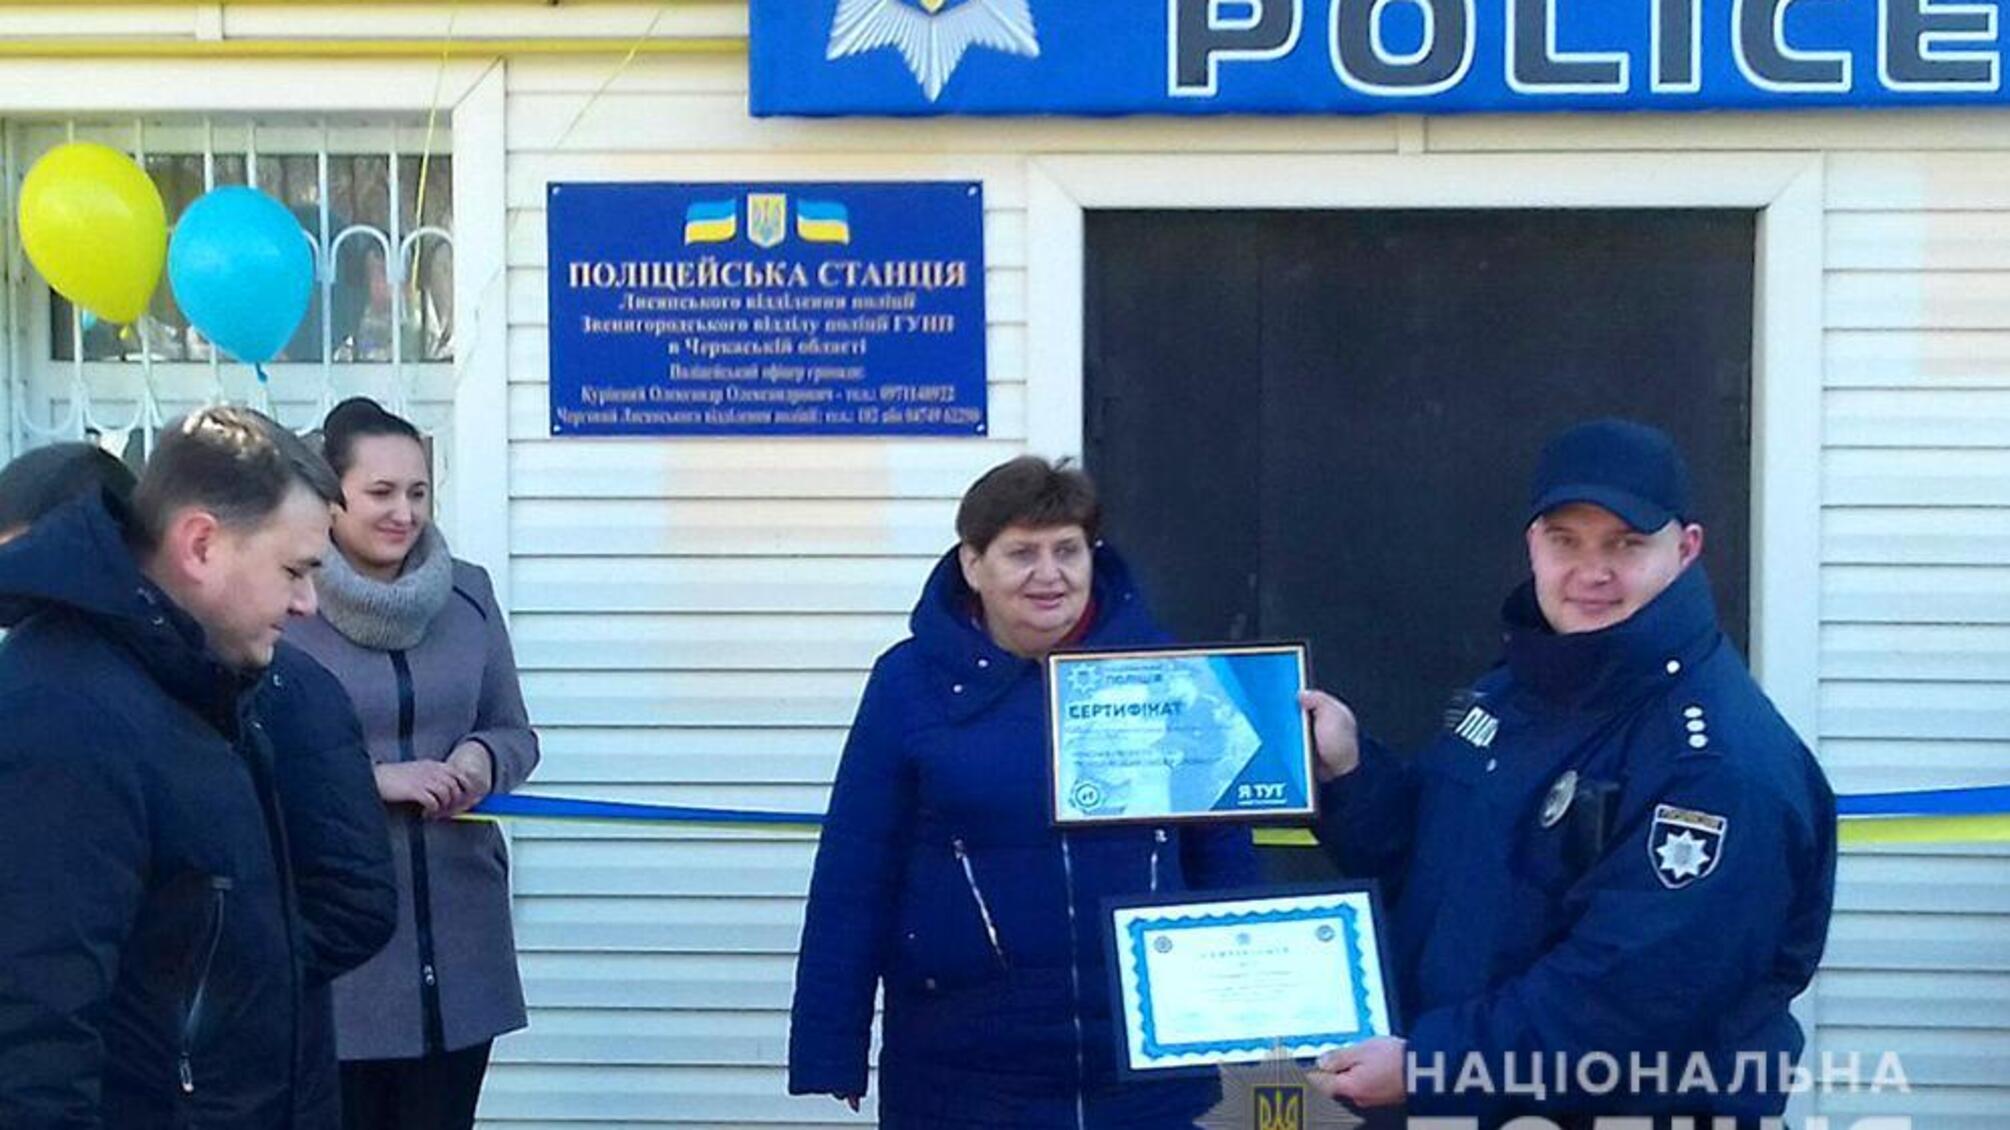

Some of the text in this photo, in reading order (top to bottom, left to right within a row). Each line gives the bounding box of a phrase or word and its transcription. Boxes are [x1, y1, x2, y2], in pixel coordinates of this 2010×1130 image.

[1168, 0, 2002, 97] POLICE
[569, 256, 967, 291] ПОЛІЦЕЙСЬКА СТАНЦІЯ
[746, 292, 846, 310] відділення
[851, 292, 916, 310] поліції
[582, 314, 955, 336] Звенигородського відділу поліції ГУНП
[684, 337, 793, 358] Черкаській
[797, 337, 866, 354] області
[1068, 700, 1184, 719] СЕРТИФІКАТ
[1253, 782, 1287, 798] ТУТ
